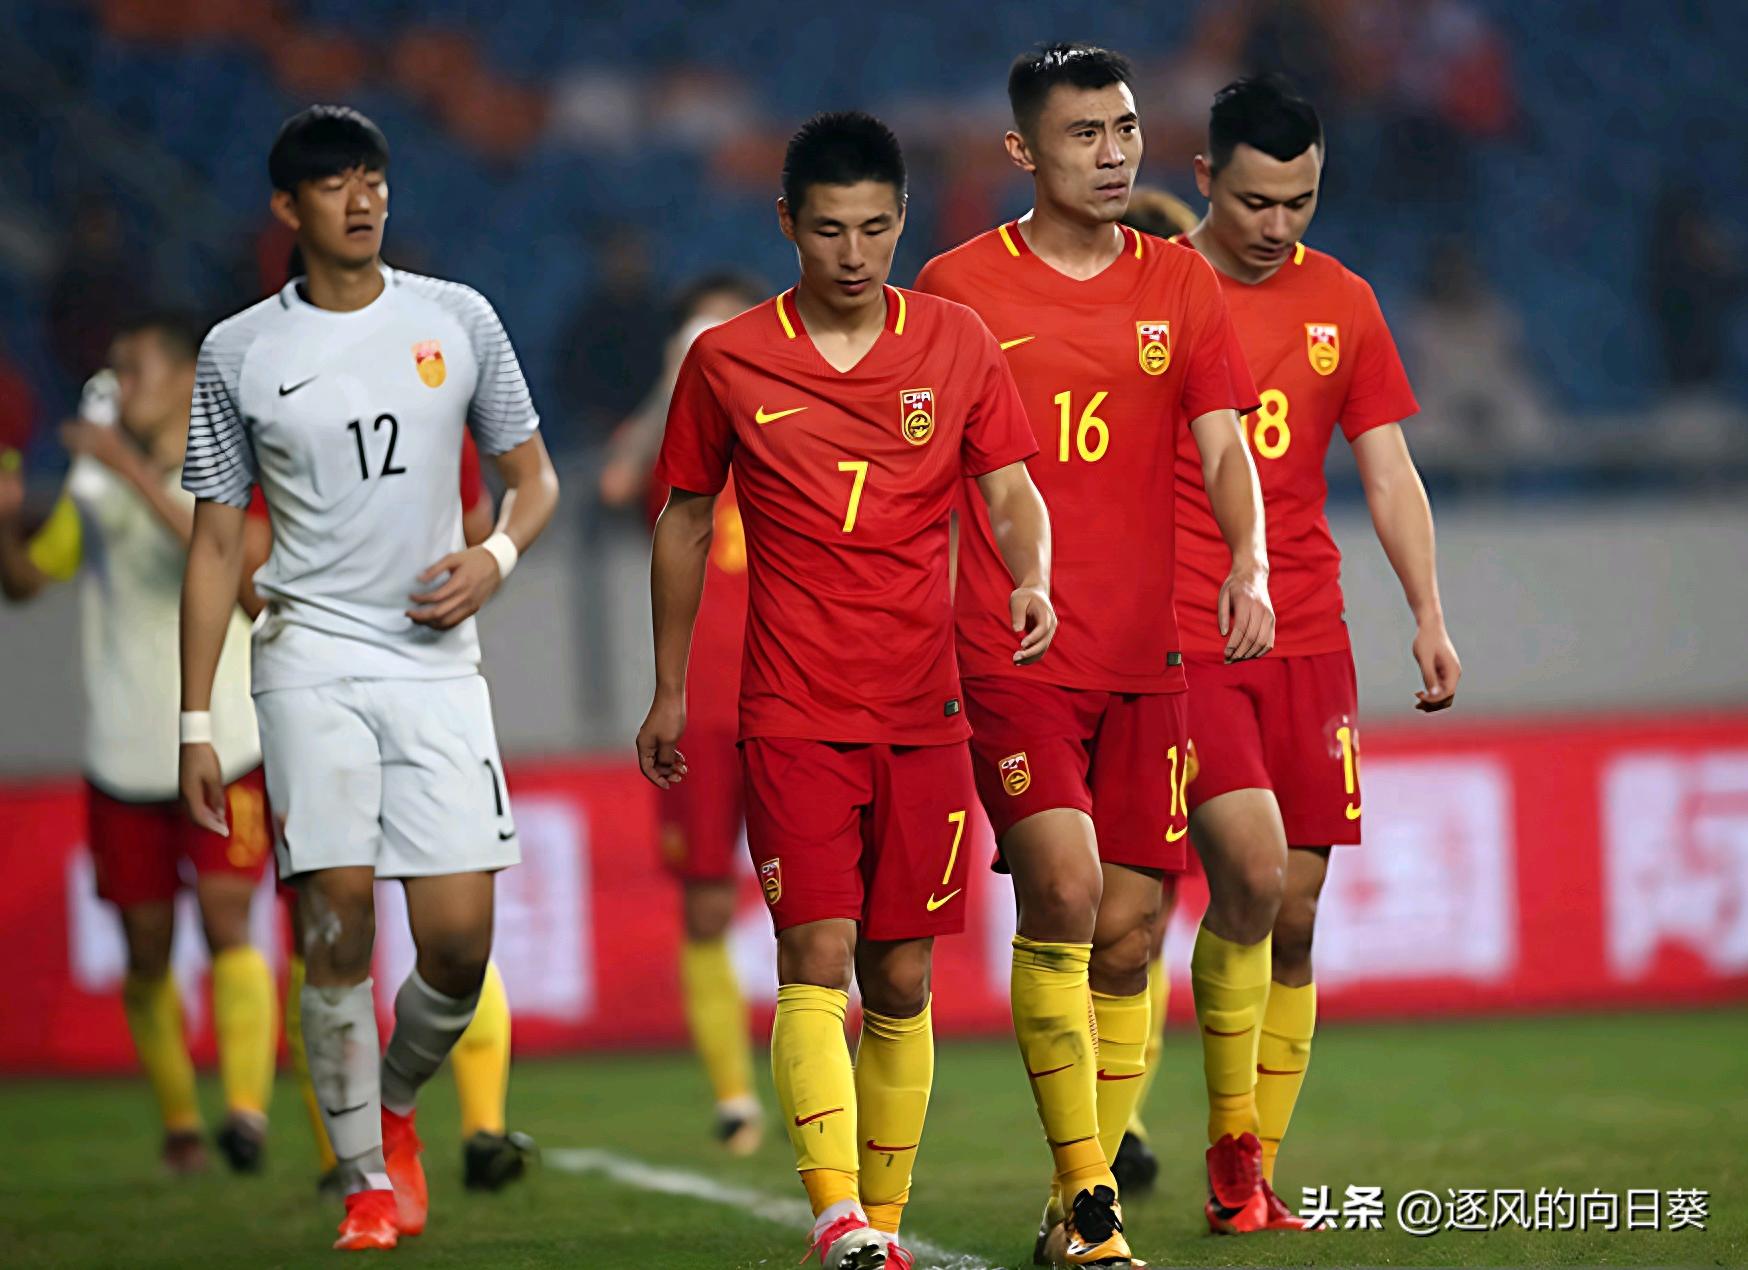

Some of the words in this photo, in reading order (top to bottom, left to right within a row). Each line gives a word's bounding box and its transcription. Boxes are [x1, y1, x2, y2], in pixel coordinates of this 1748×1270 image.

[346, 413, 406, 480] 12
[1054, 390, 1110, 462] 16
[838, 461, 869, 532] 7
[948, 810, 966, 885] 7
[880, 1153, 895, 1167] 7
